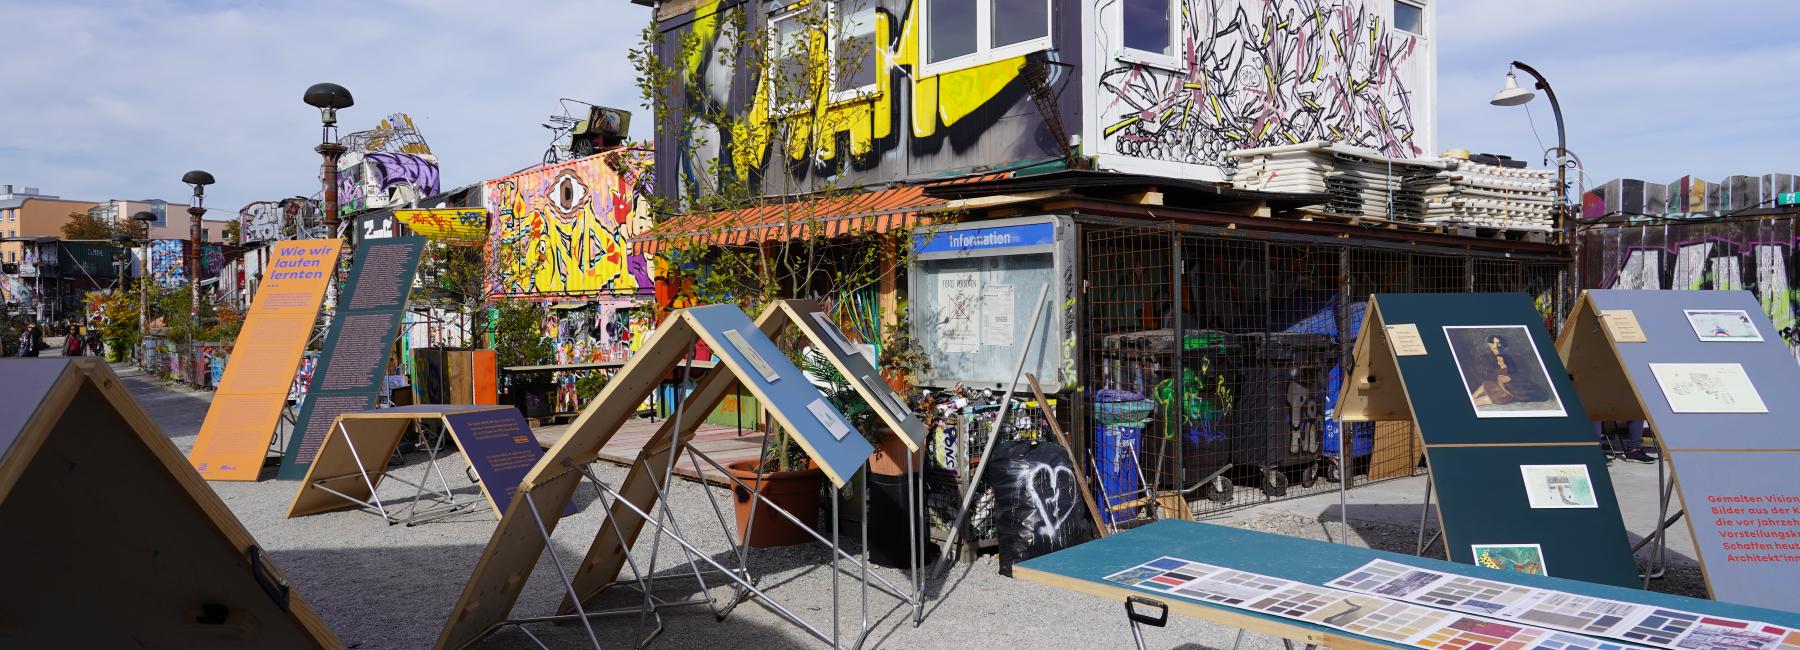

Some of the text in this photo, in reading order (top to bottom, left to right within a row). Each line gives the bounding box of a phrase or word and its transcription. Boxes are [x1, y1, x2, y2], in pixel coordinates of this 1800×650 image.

[949, 232, 1011, 248] Information
[280, 245, 332, 257] Wie wir
[275, 257, 320, 269] laufen
[270, 269, 322, 280] lernten
[1707, 495, 1800, 503] Gemalten Vision
[1711, 506, 1745, 515] Bilder
[1748, 507, 1769, 515] aus
[1771, 506, 1790, 515] der
[1715, 518, 1800, 528] die vor Jahrzeh
[1723, 541, 1773, 550] Schaffen
